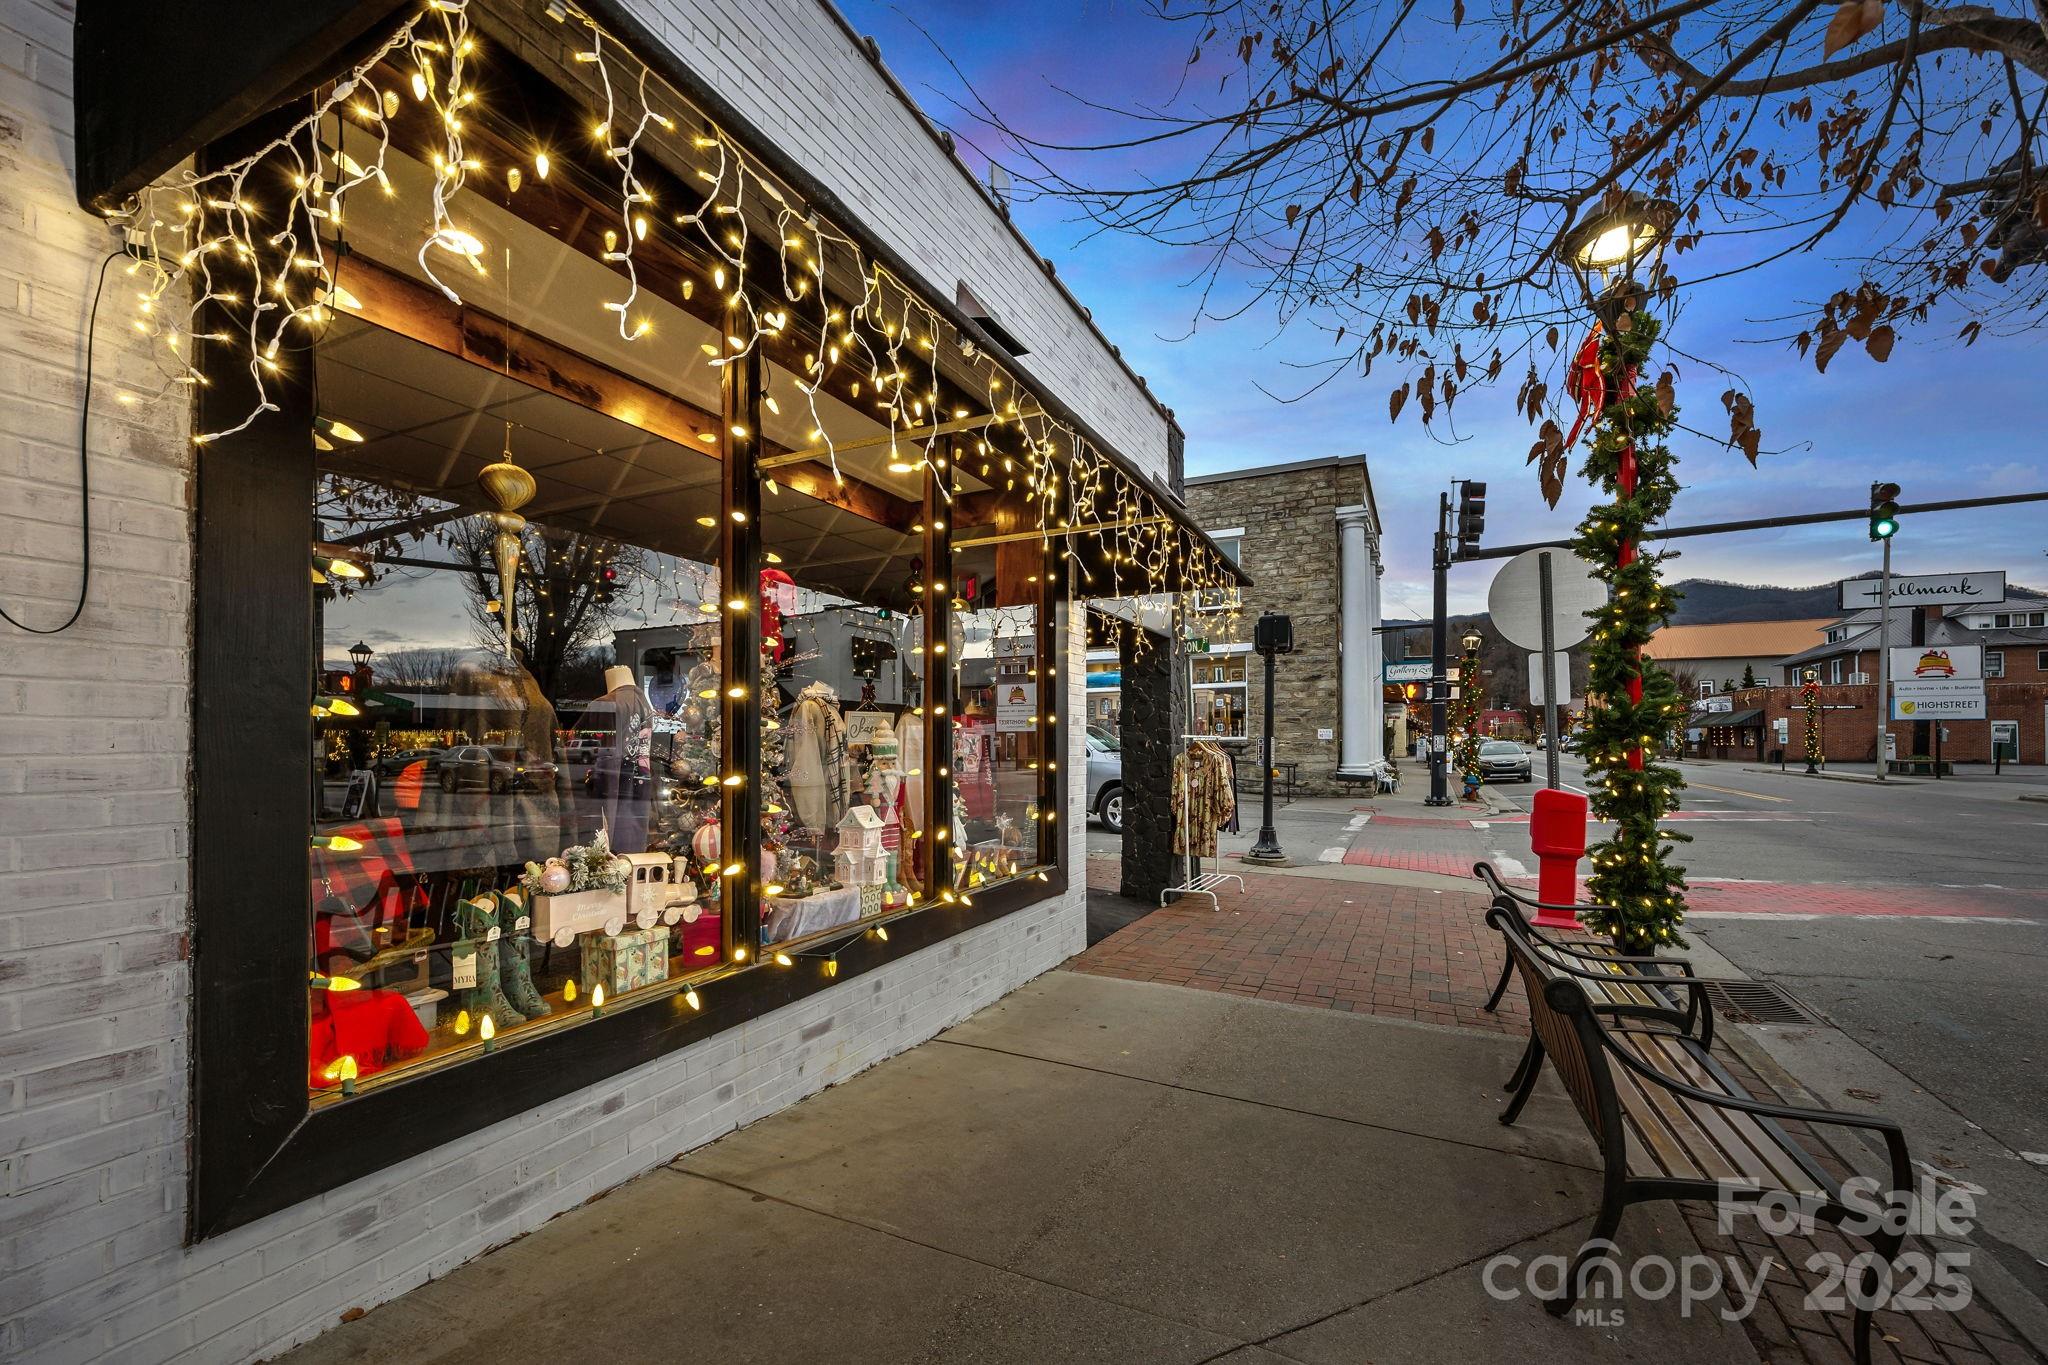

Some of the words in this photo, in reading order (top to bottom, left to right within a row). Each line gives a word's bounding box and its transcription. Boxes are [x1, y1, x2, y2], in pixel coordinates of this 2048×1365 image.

[1862, 577, 1983, 605] Hallmark
[1389, 665, 1418, 677] Gallery
[1917, 700, 1980, 710] HIGHSTREET
[454, 975, 477, 985] MYRA
